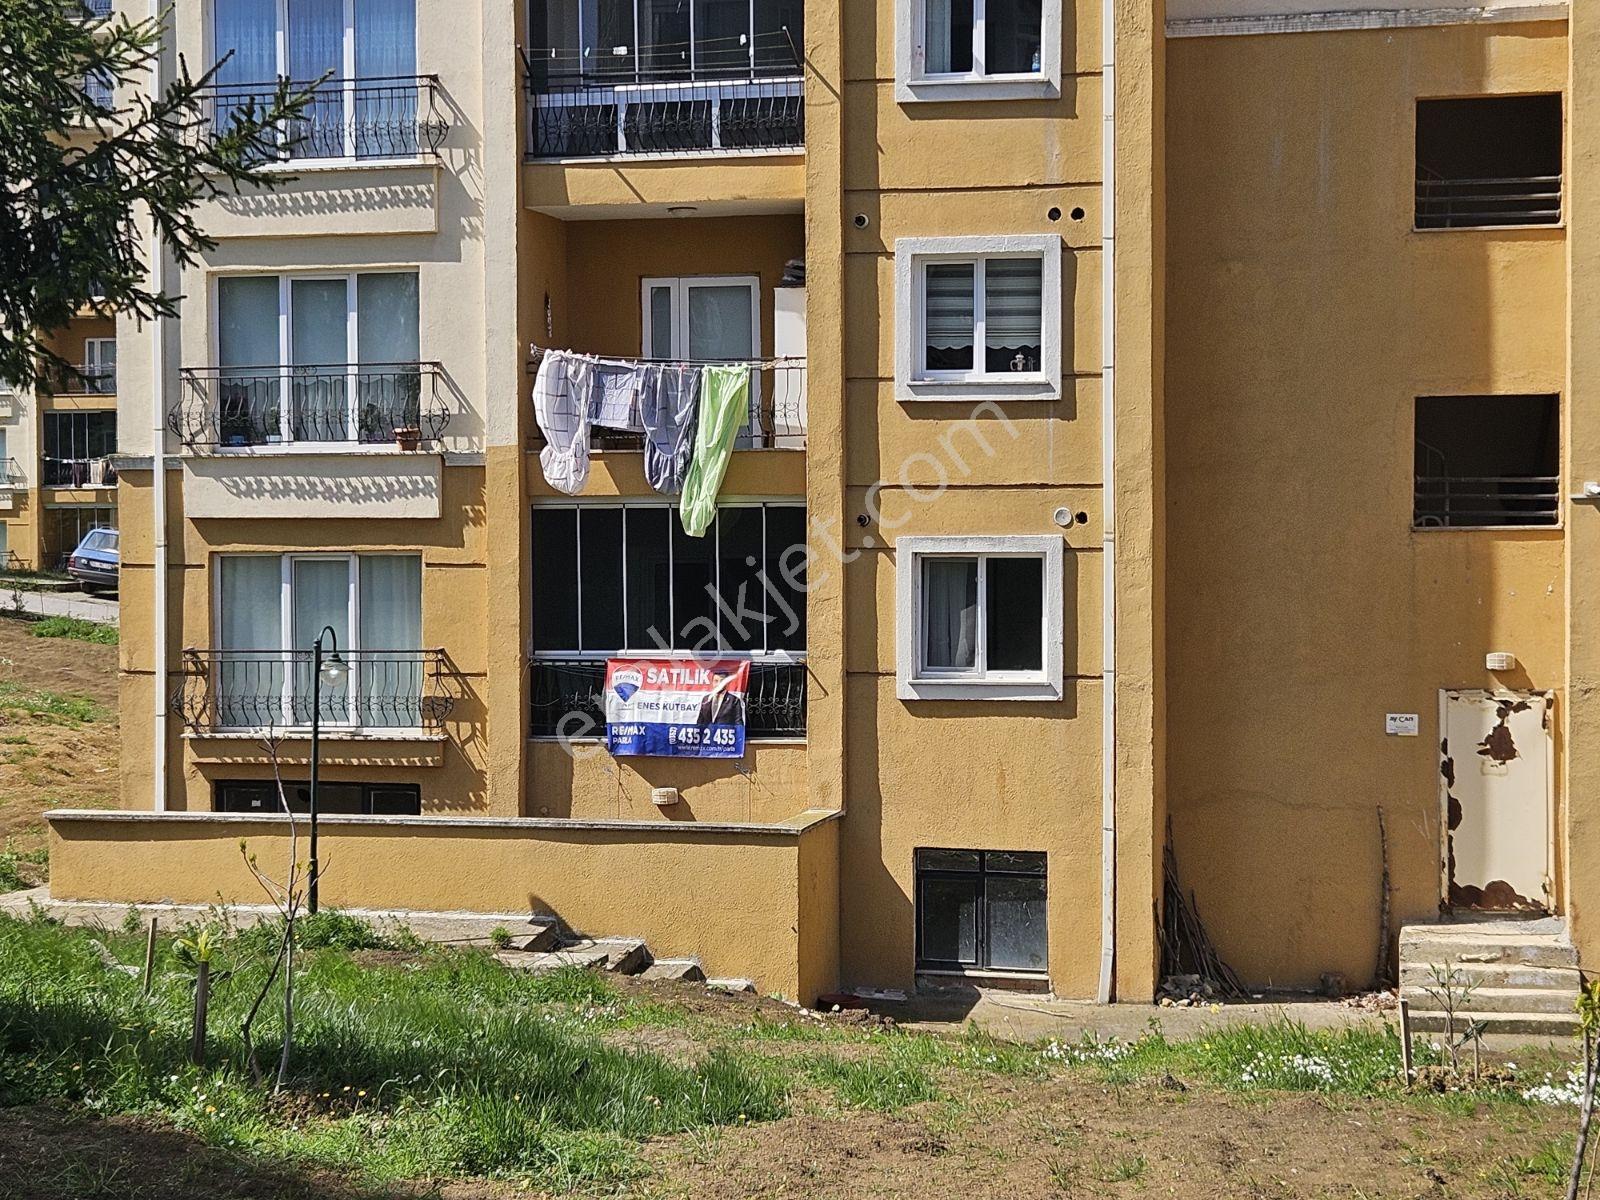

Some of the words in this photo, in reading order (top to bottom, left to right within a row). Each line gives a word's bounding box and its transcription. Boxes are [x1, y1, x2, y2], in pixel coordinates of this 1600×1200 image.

[647, 668, 711, 685] SATILIK
[637, 702, 660, 710] ENES
[662, 703, 698, 712] KUTBAY
[612, 726, 645, 735] RE/MAX
[678, 728, 701, 744] 435
[702, 728, 711, 744] 2
[713, 729, 736, 745] 435
